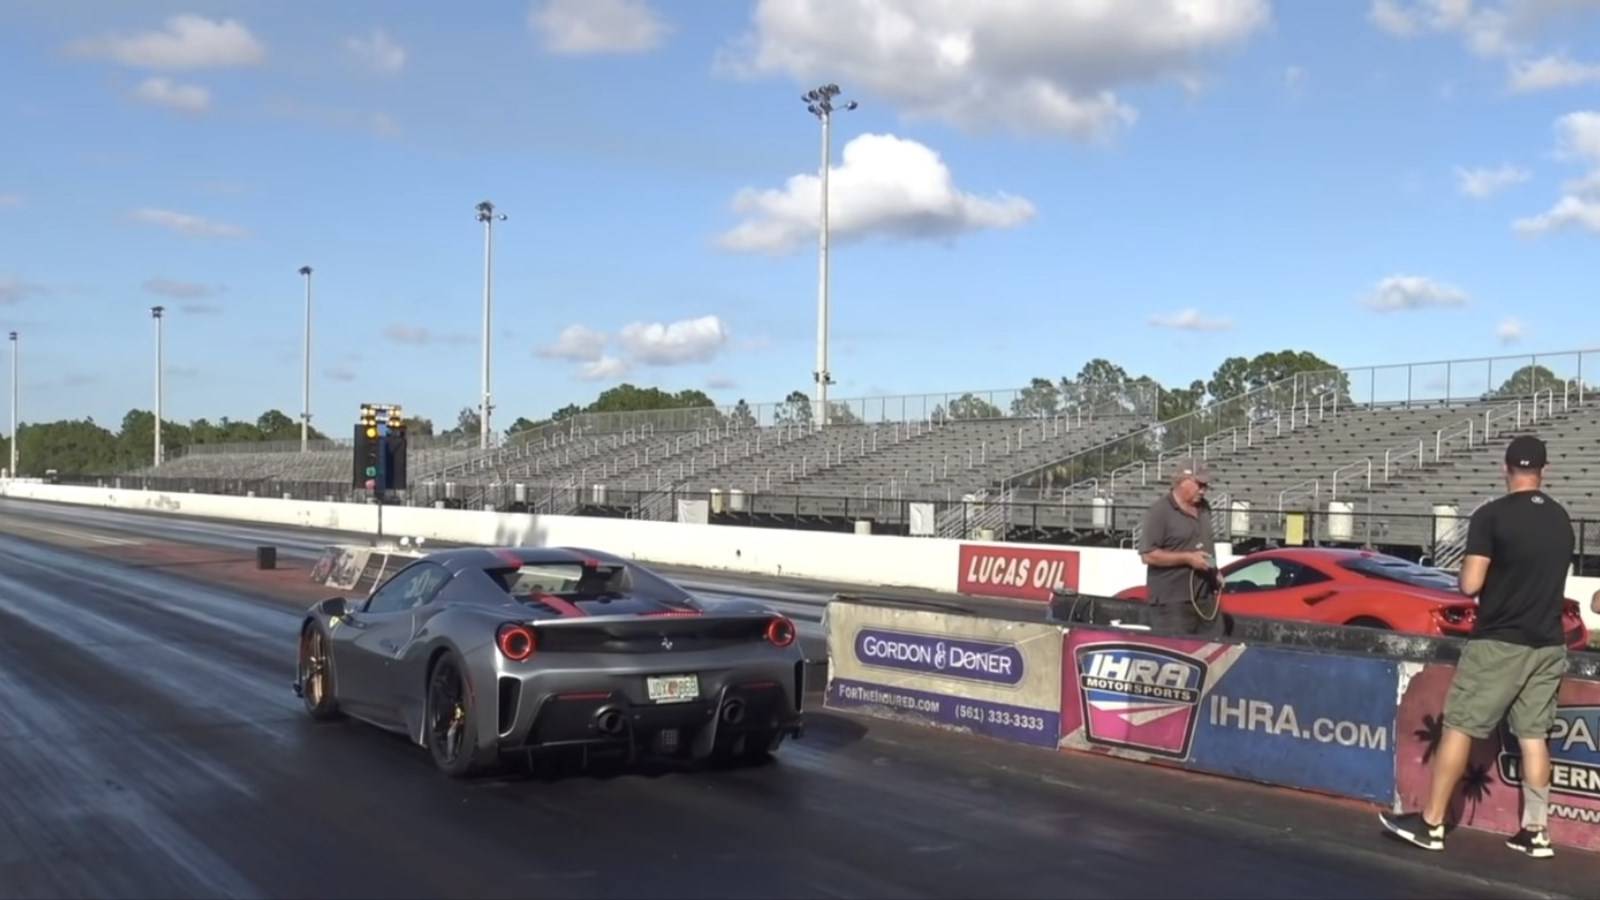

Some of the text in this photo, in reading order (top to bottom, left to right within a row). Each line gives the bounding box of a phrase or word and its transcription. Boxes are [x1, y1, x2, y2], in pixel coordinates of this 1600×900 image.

[967, 555, 1064, 590] LUCAS OIL
[863, 636, 1012, 675] GORDON & DONER
[1088, 653, 1190, 689] IHRA
[1086, 677, 1192, 701] MOTORSPORTS
[955, 704, 984, 723] (561)
[988, 709, 1044, 731] 333-3333
[1210, 695, 1387, 751] IHRA.COM
